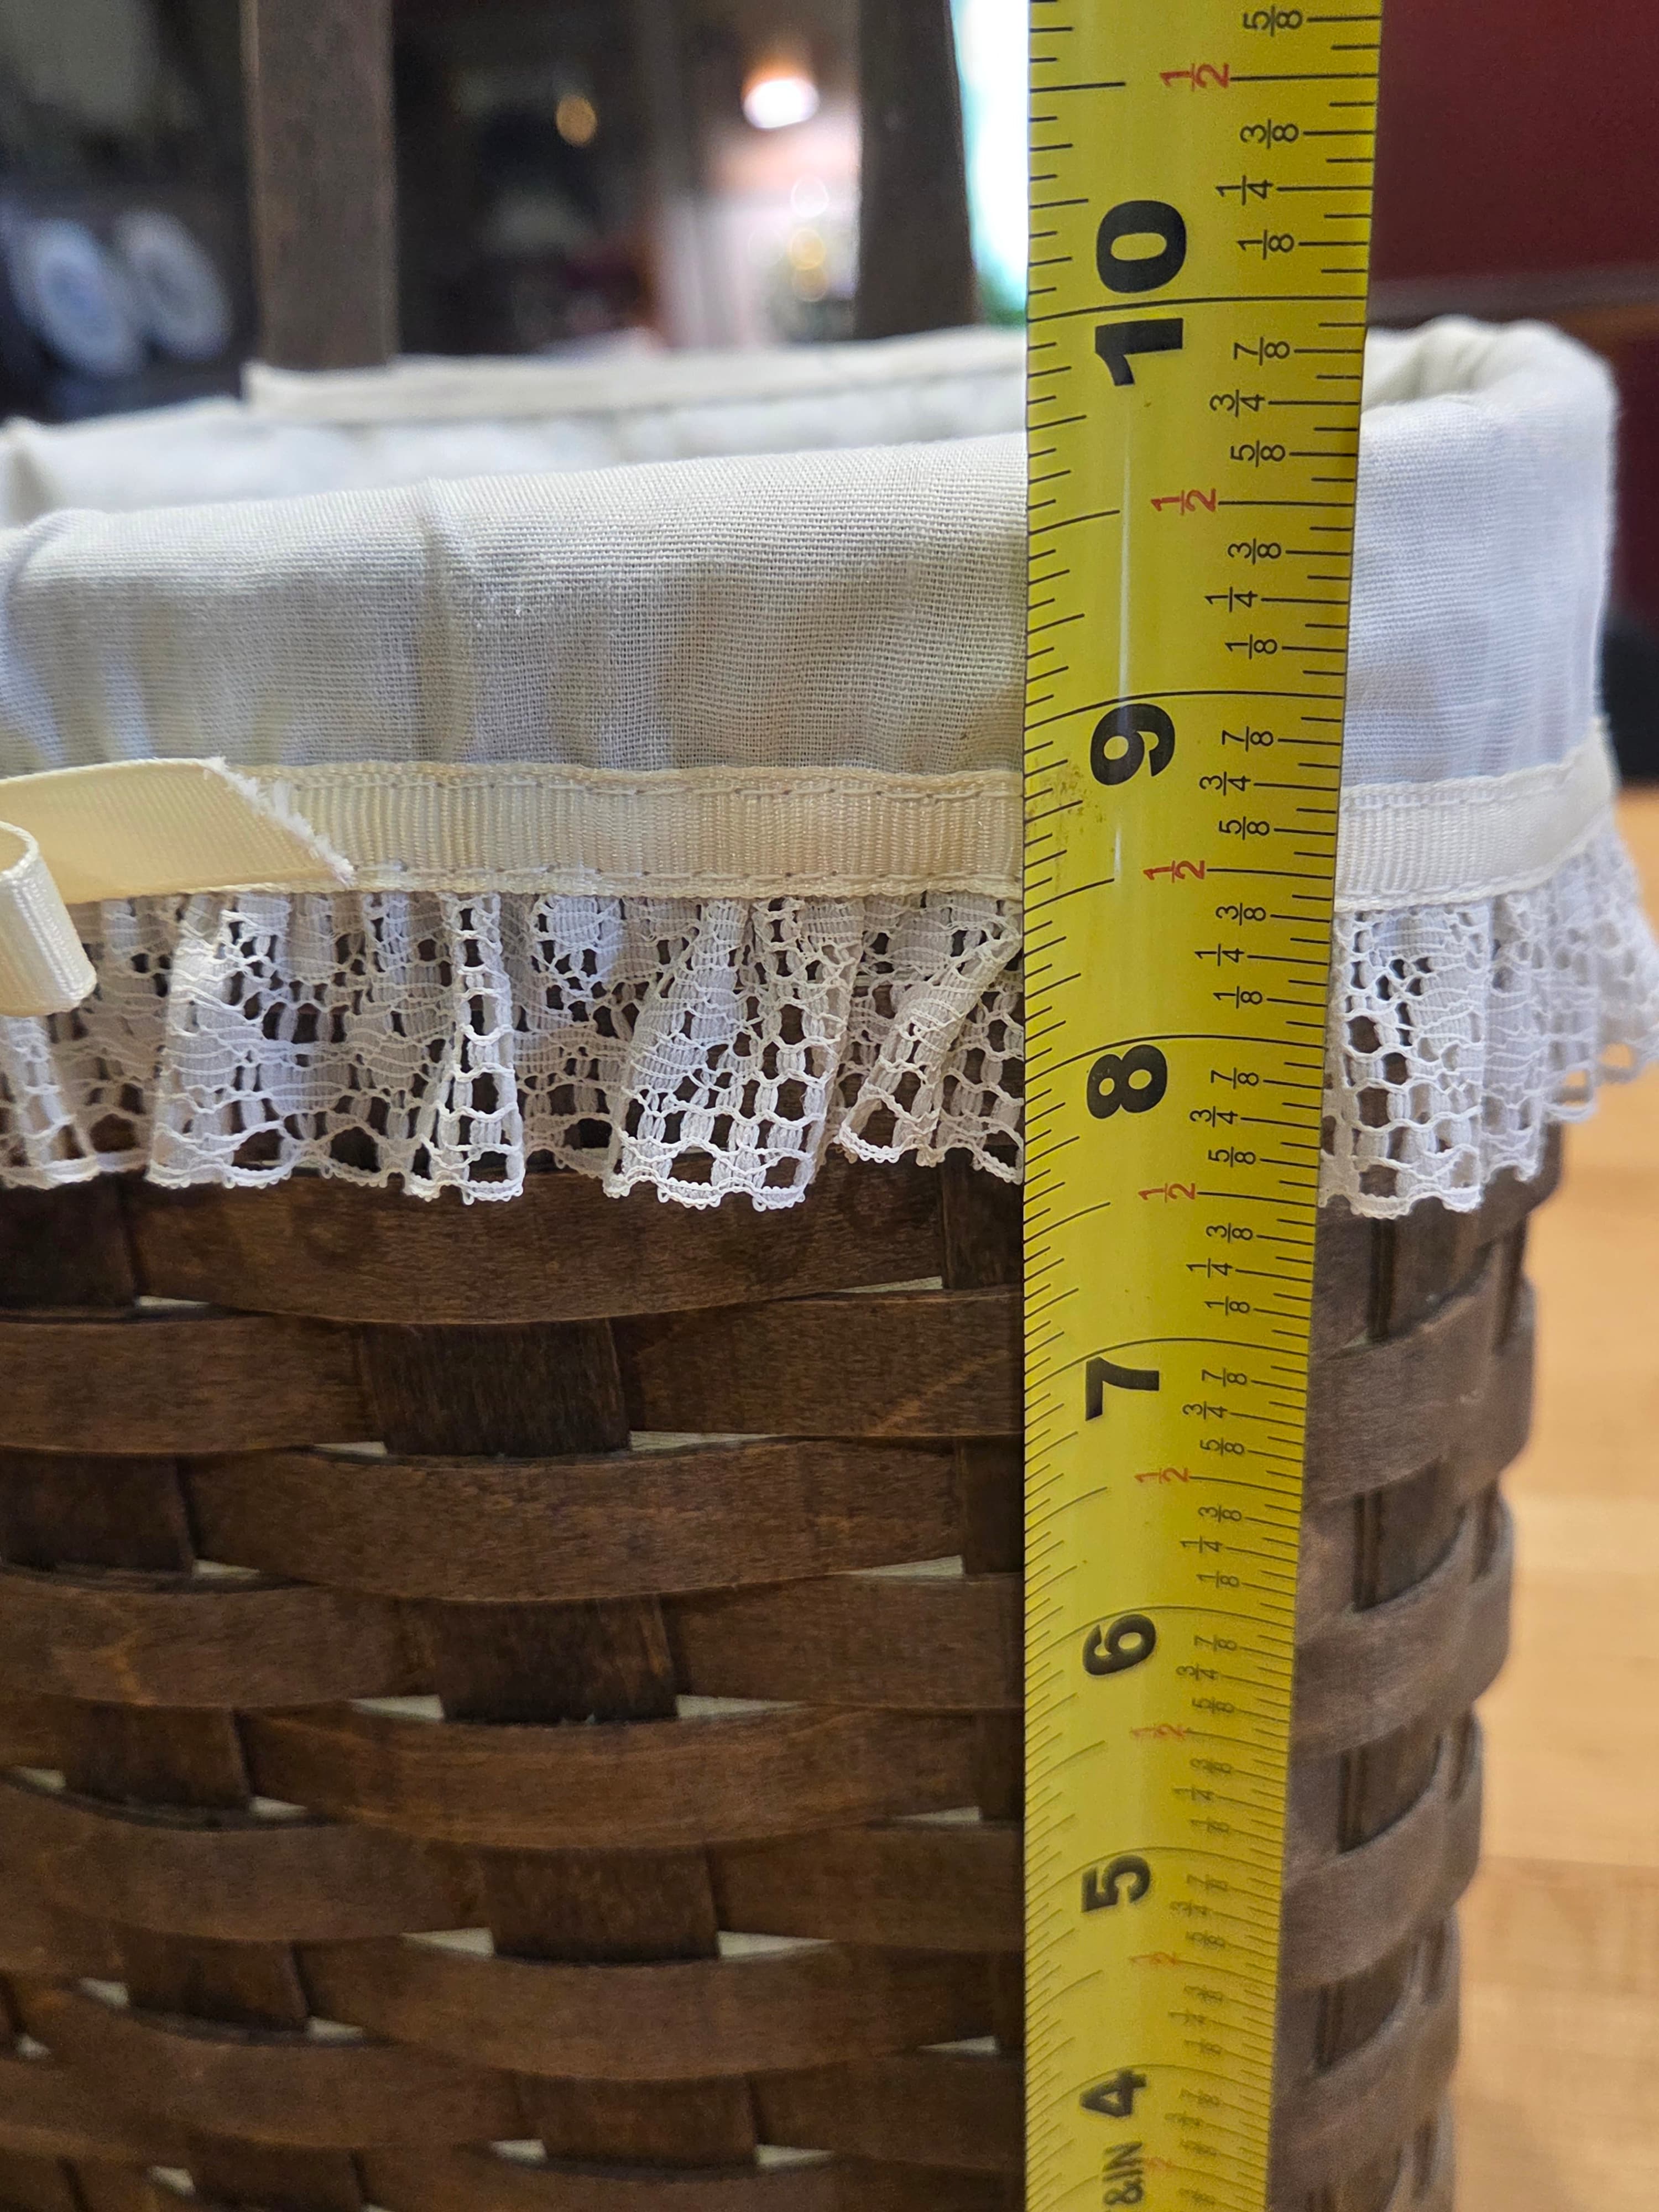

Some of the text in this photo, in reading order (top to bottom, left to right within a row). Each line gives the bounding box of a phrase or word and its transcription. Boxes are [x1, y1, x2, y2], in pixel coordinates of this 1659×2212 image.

[1095, 200, 1187, 386] 10
[1091, 703, 1175, 785] 9
[1087, 1044, 1168, 1119] 8
[1086, 1357, 1160, 1421] 7
[1082, 1614, 1156, 1676] 6
[1081, 1855, 1151, 1913] 5
[1079, 2068, 1147, 2118] 4
